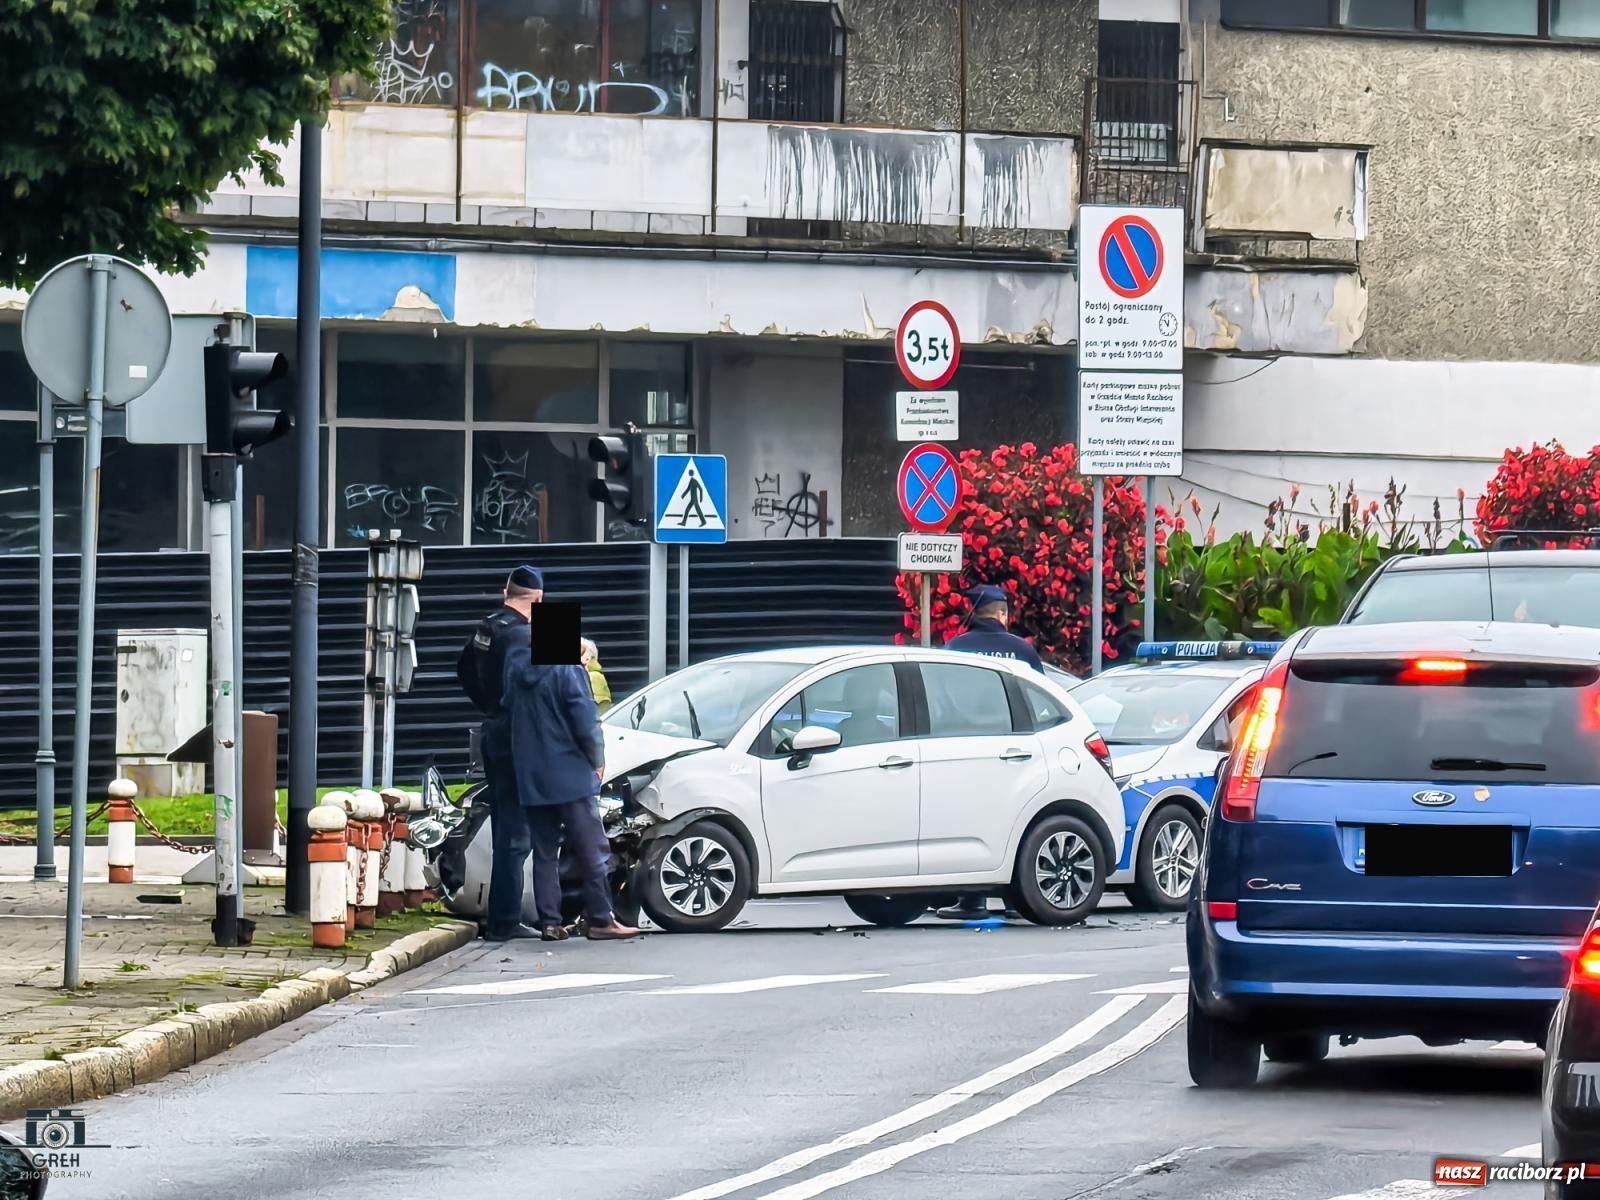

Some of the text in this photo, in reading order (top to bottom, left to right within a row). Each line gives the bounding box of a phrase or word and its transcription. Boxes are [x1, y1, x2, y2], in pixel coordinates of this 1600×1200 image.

[1113, 303, 1163, 313] ograniczony
[1085, 316, 1096, 324] do
[1100, 316, 1104, 324] 2
[907, 329, 949, 365] 3,5t
[906, 542, 958, 552] NIE DOTYCZY
[910, 554, 952, 564] CHODNIKA
[1178, 643, 1216, 655] POLICJA
[1422, 791, 1445, 802] Ford
